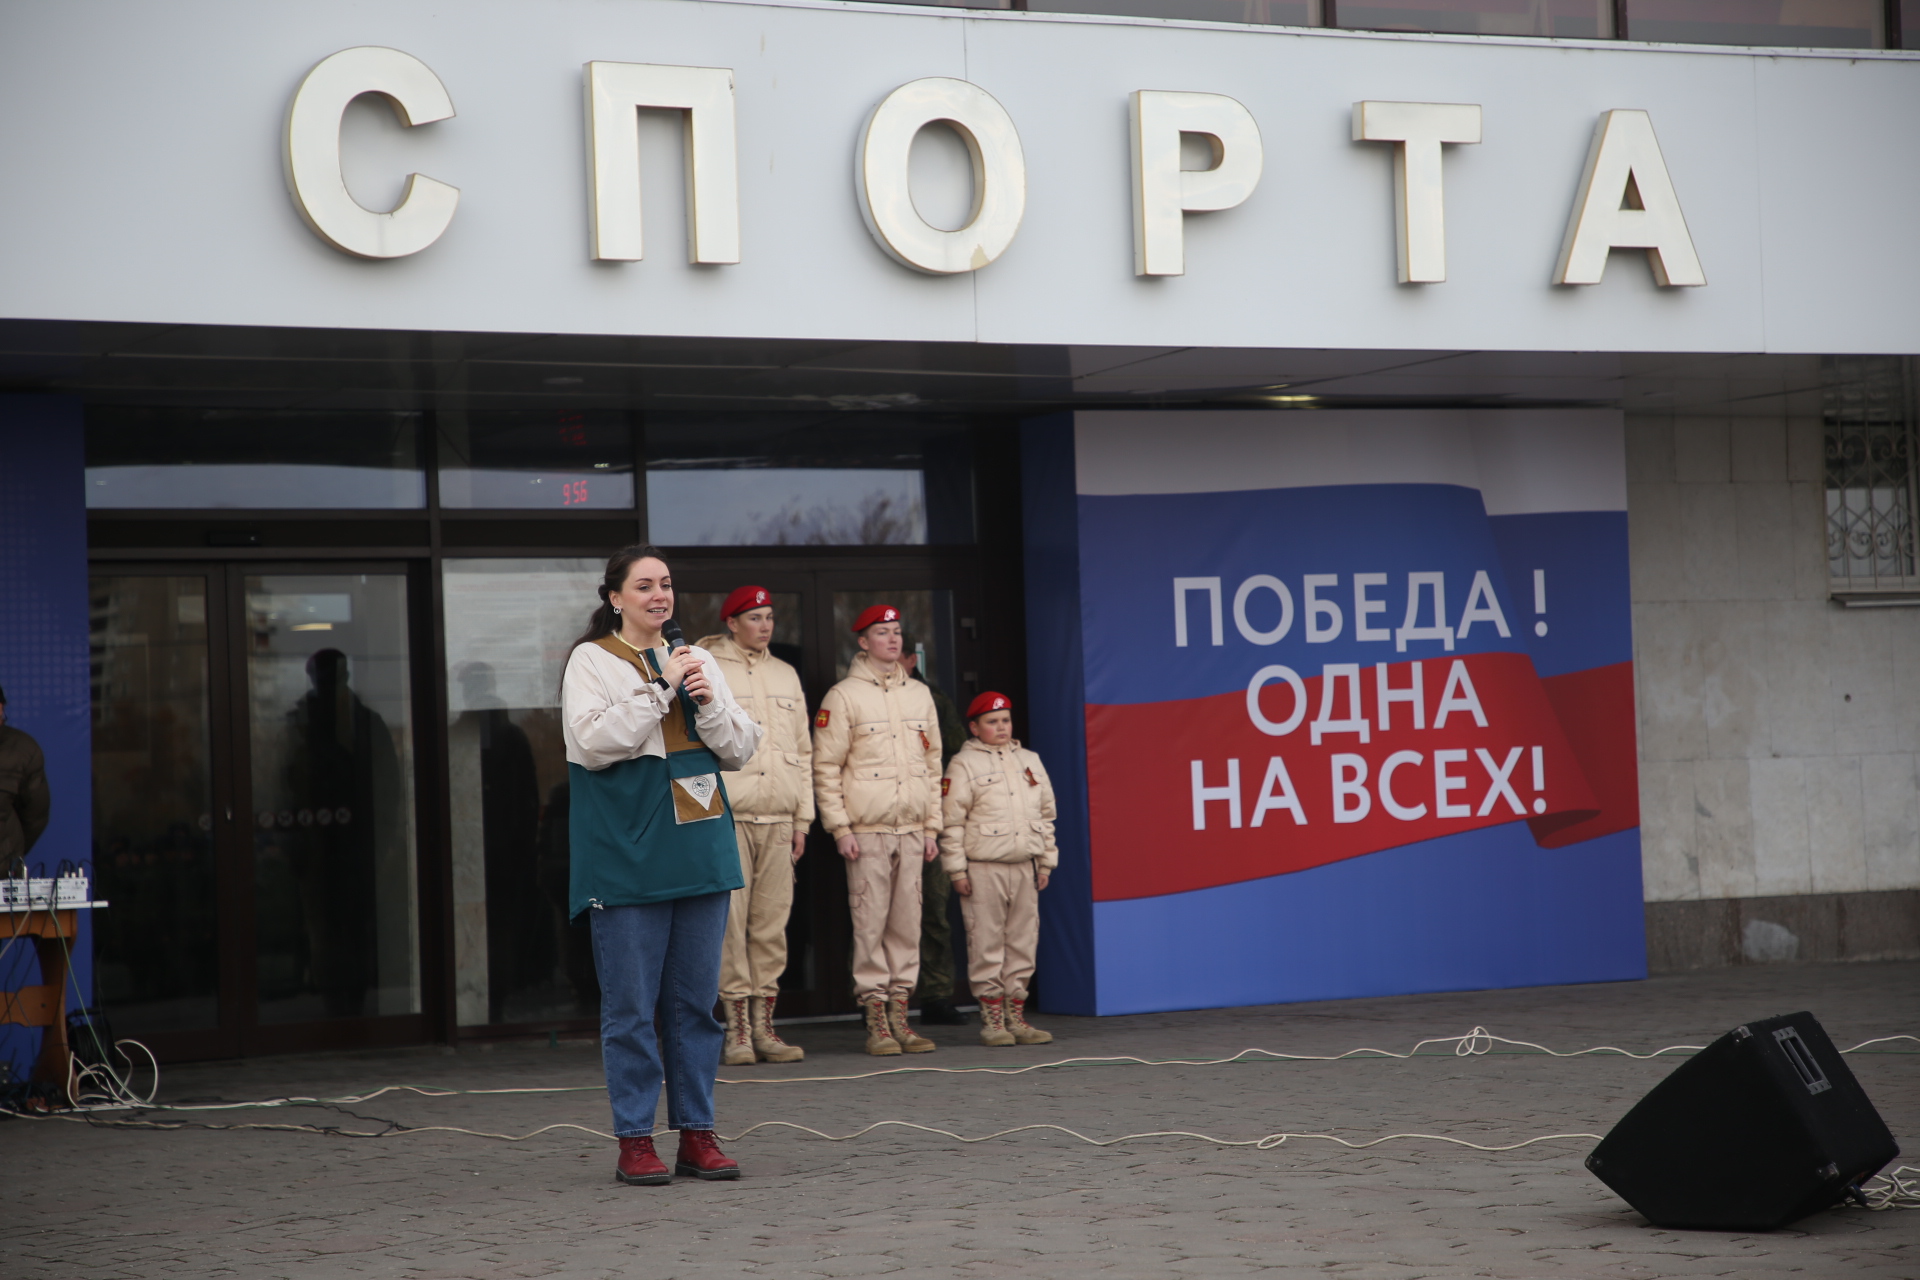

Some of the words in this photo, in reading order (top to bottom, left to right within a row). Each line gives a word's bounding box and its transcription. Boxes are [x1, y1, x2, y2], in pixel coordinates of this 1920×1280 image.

[281, 45, 1707, 287] СПОРТА
[1246, 659, 1489, 746] ОДНА
[1190, 756, 1308, 831] НА
[1331, 746, 1547, 824] ВСЕХ!
